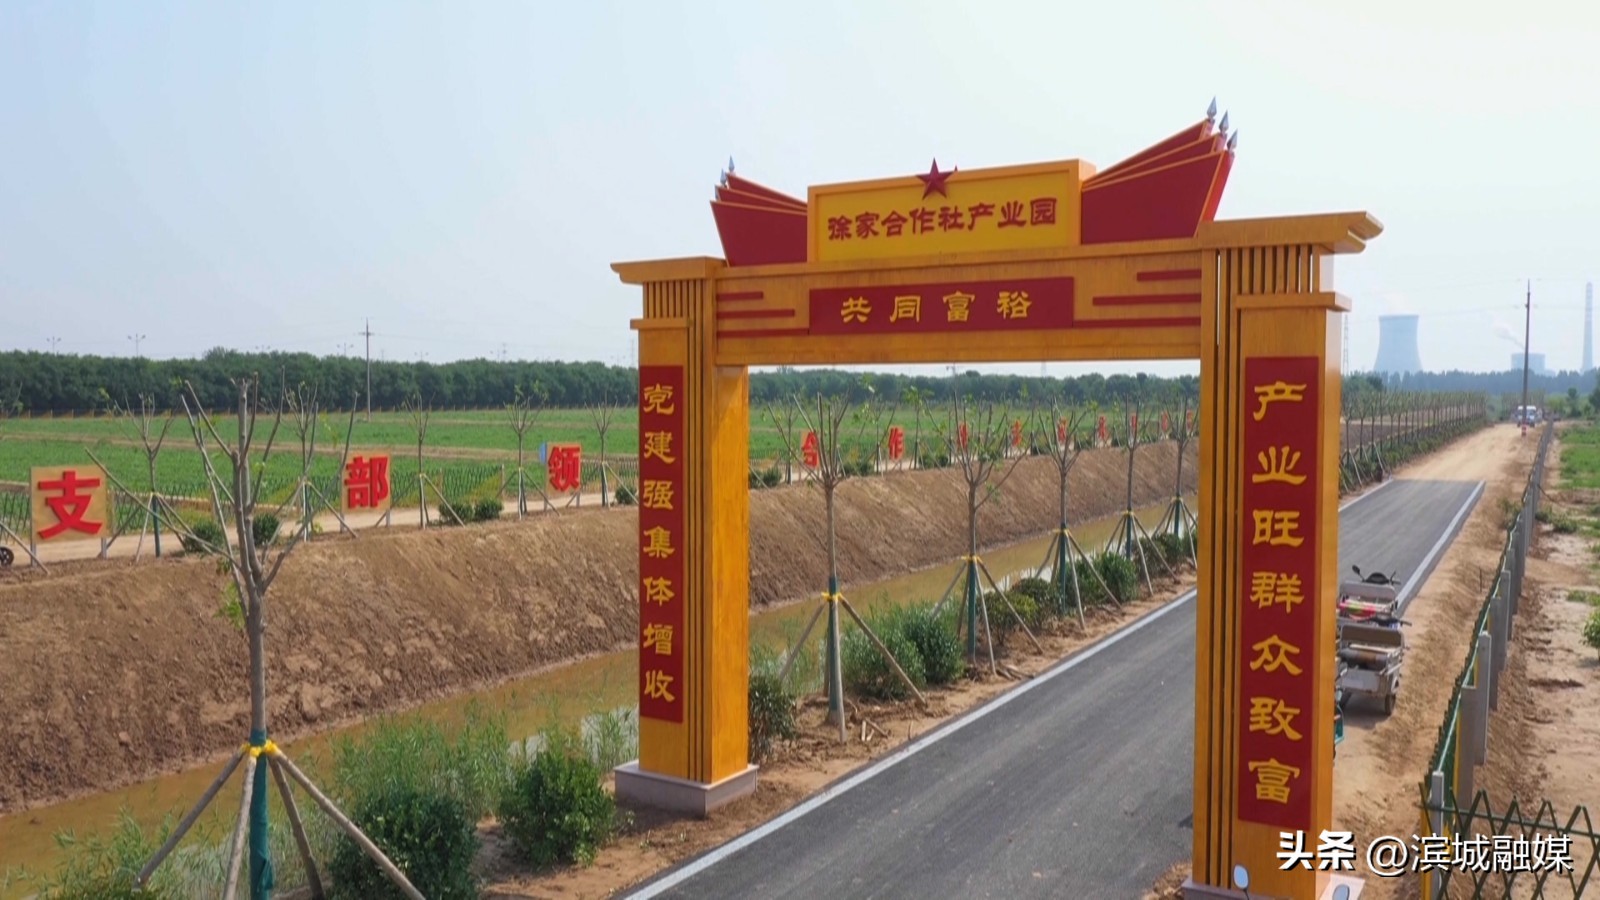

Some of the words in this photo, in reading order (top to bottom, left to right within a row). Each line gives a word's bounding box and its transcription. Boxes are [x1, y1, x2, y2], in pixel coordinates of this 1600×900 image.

[828, 197, 1057, 241] 徐家合作社产业园
[840, 290, 1032, 323] 共同富裕
[344, 456, 388, 509] 部
[548, 446, 580, 492] 领
[37, 471, 103, 539] 支
[643, 383, 675, 702] 党建强集体增收
[1248, 381, 1307, 804] 产业旺群众致富
